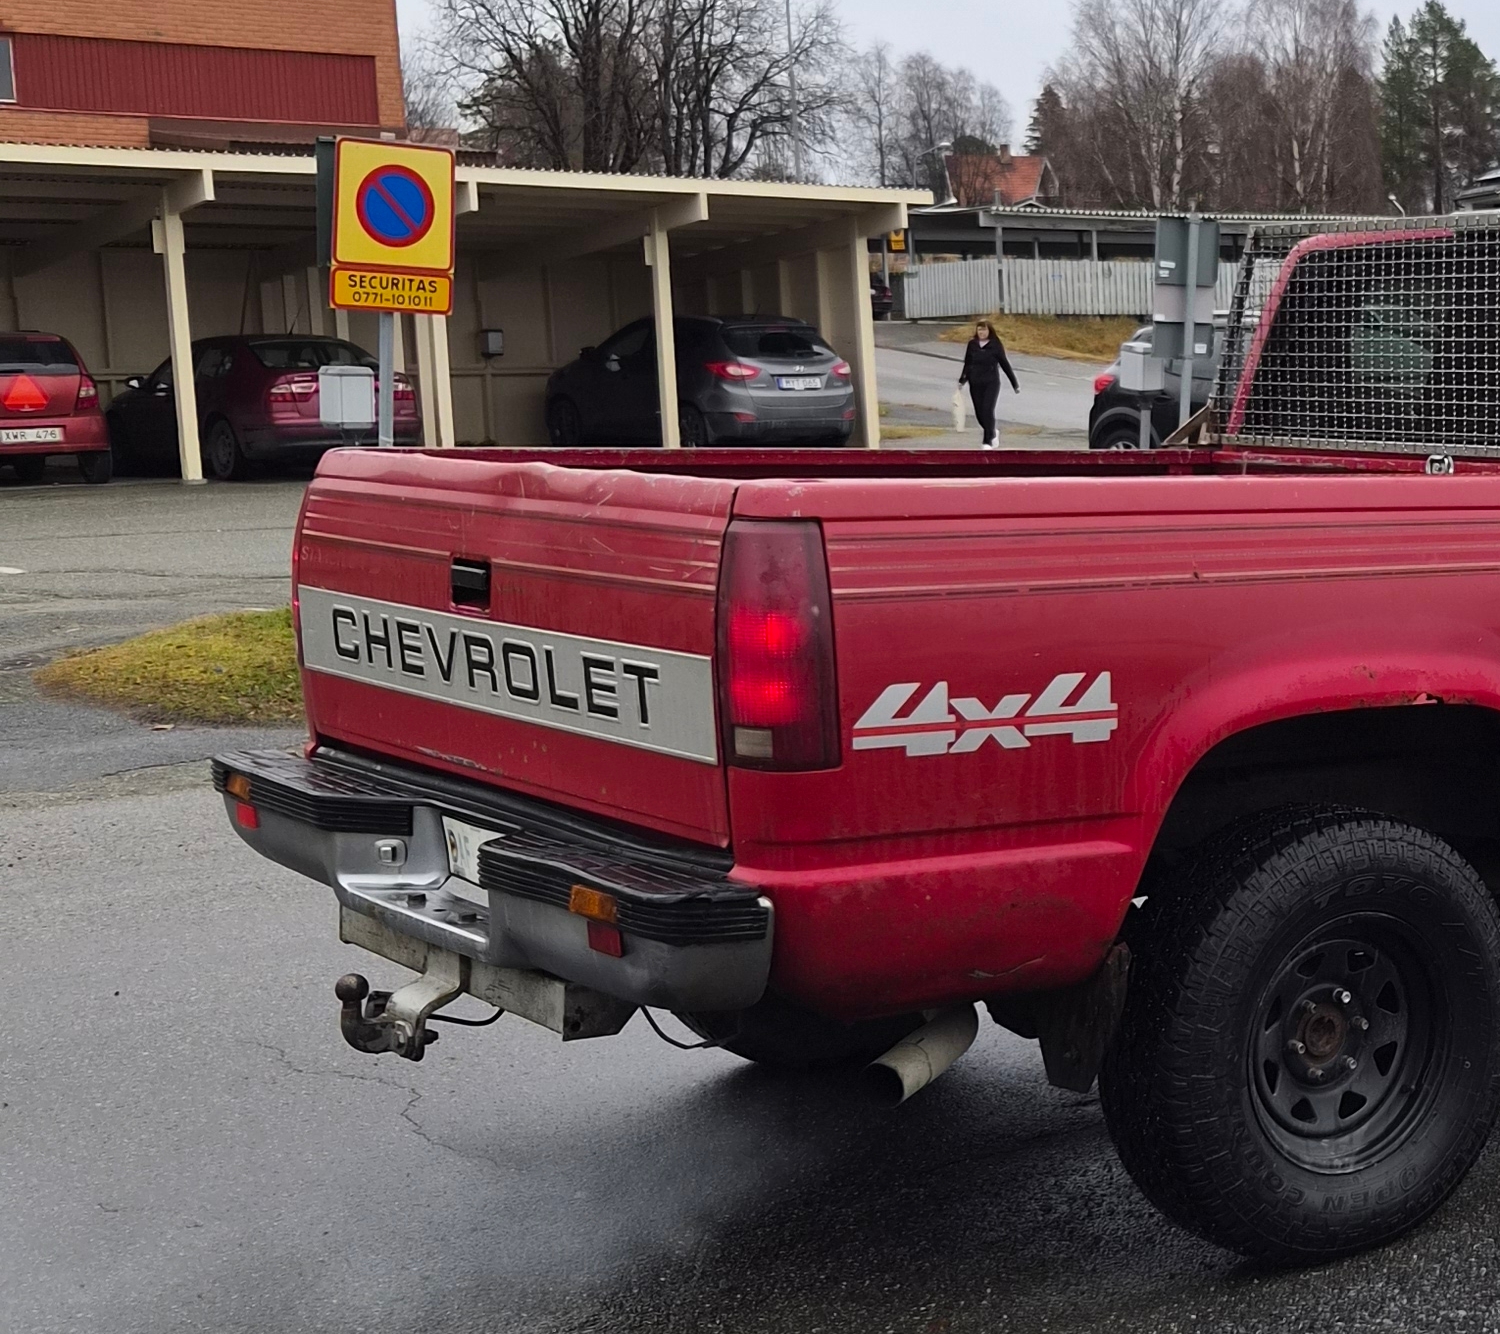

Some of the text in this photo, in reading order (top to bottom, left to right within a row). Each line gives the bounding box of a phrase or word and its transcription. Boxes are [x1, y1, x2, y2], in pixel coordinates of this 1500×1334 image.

[348, 274, 437, 293] SECURITAS
[4, 430, 57, 440] XWR 476
[332, 605, 660, 727] CHEVROLET
[852, 671, 1118, 757] 4x4
[1312, 875, 1440, 910] TOYO
[1322, 1165, 1422, 1213] OPEN
